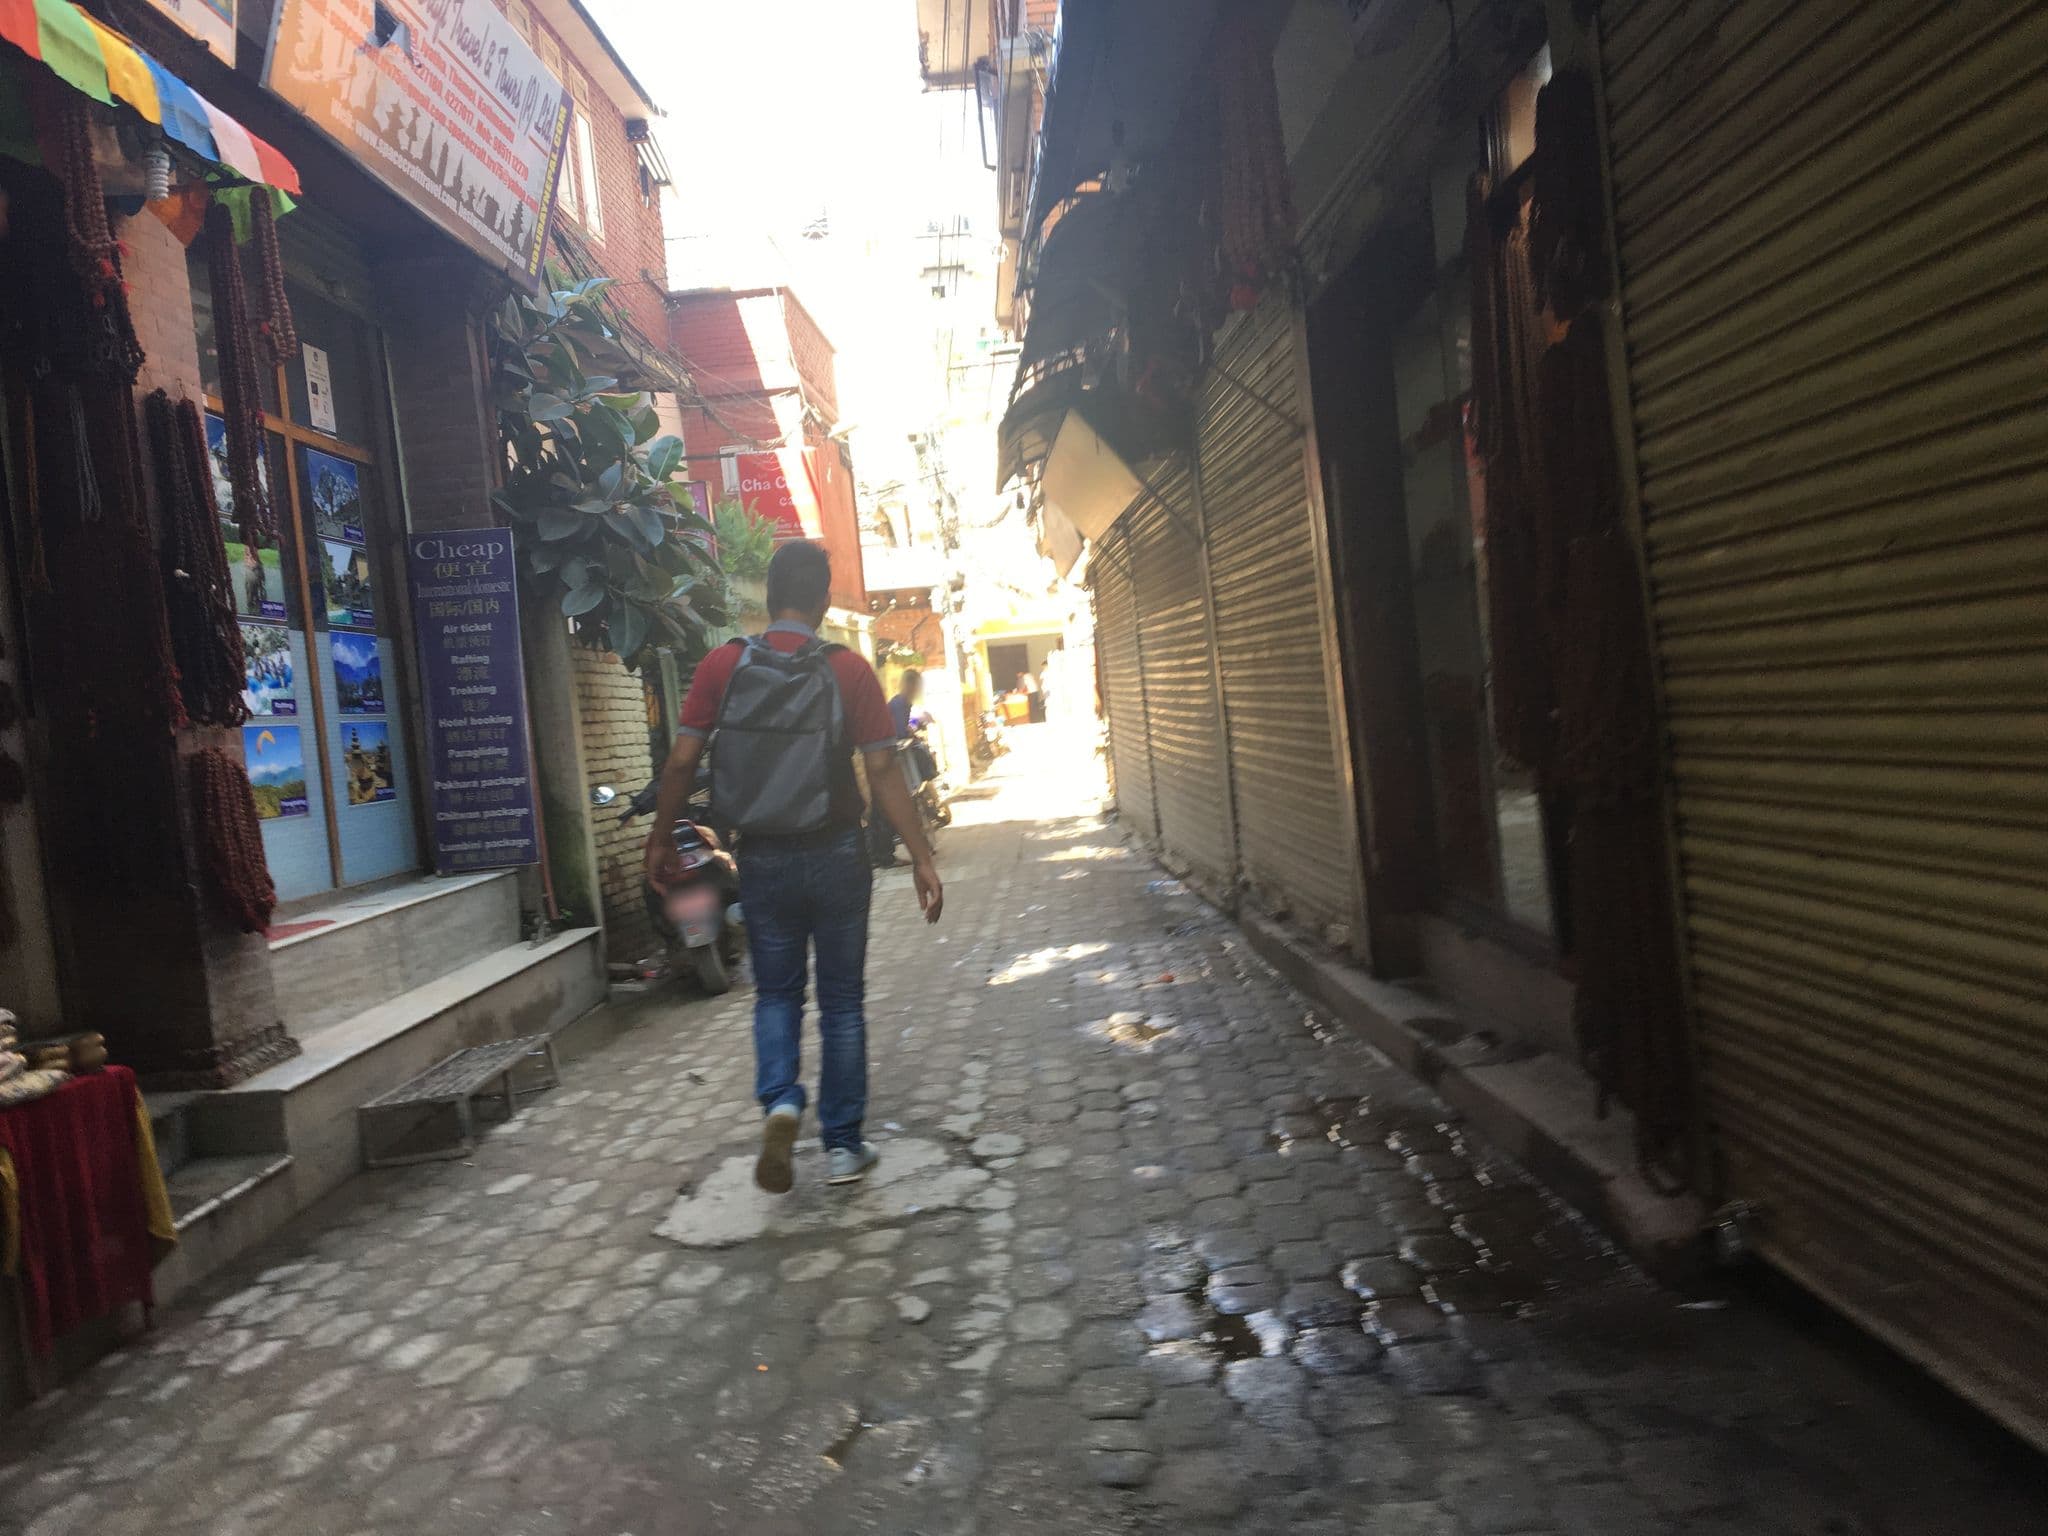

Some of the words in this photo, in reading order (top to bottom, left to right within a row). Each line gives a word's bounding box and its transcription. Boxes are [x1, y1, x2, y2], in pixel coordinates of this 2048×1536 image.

[483, 39, 497, 79] &
[742, 478, 771, 492] Cha
[415, 540, 504, 560] Cheap
[443, 624, 458, 634] Air
[461, 622, 493, 633] ticket
[449, 686, 497, 696] Trekking
